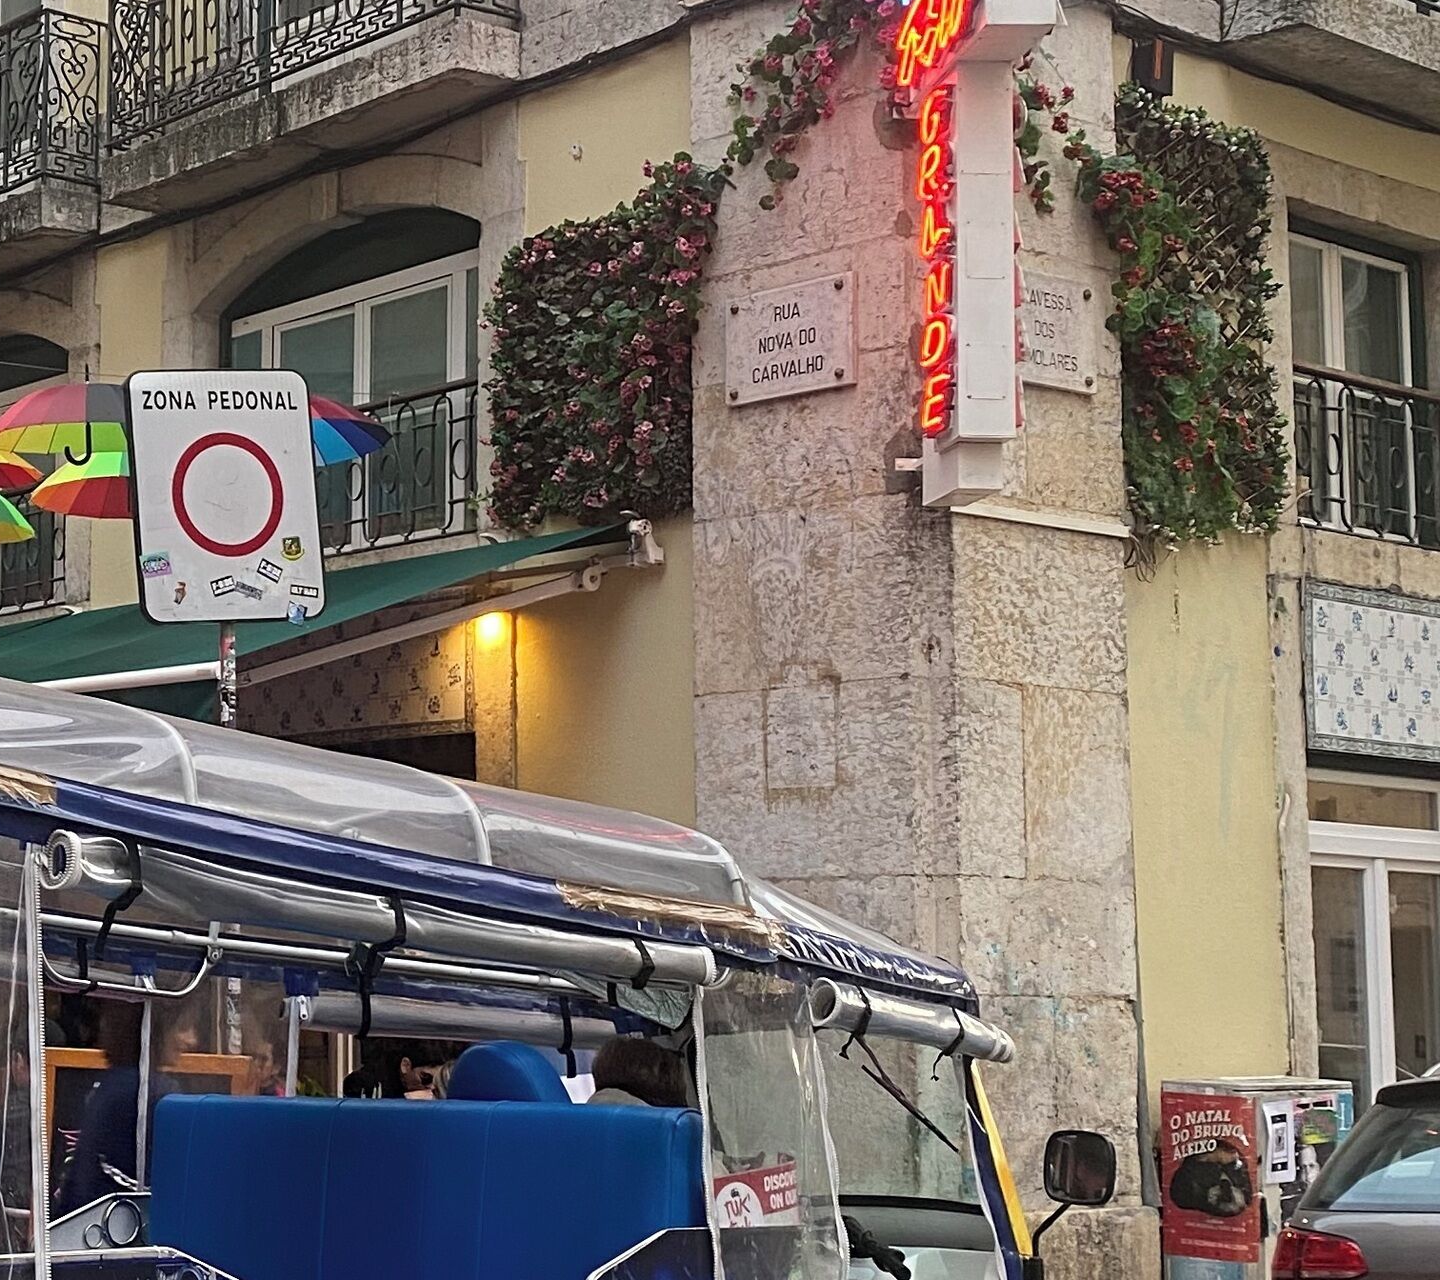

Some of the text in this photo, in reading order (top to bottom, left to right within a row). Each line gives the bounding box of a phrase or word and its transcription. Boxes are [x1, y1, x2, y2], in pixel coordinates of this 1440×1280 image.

[1029, 289, 1073, 313] AVESSA
[773, 302, 800, 322] RUA
[1034, 319, 1056, 339] DOS
[758, 327, 817, 354] NOVA DO
[752, 354, 825, 384] CARVALHO
[141, 390, 298, 411] ZONA PEDONAL
[1170, 1109, 1232, 1130] O NATAL
[1171, 1124, 1244, 1146] DO BRUNO
[1173, 1139, 1218, 1161] ALEIXO
[770, 1192, 784, 1209] ON
